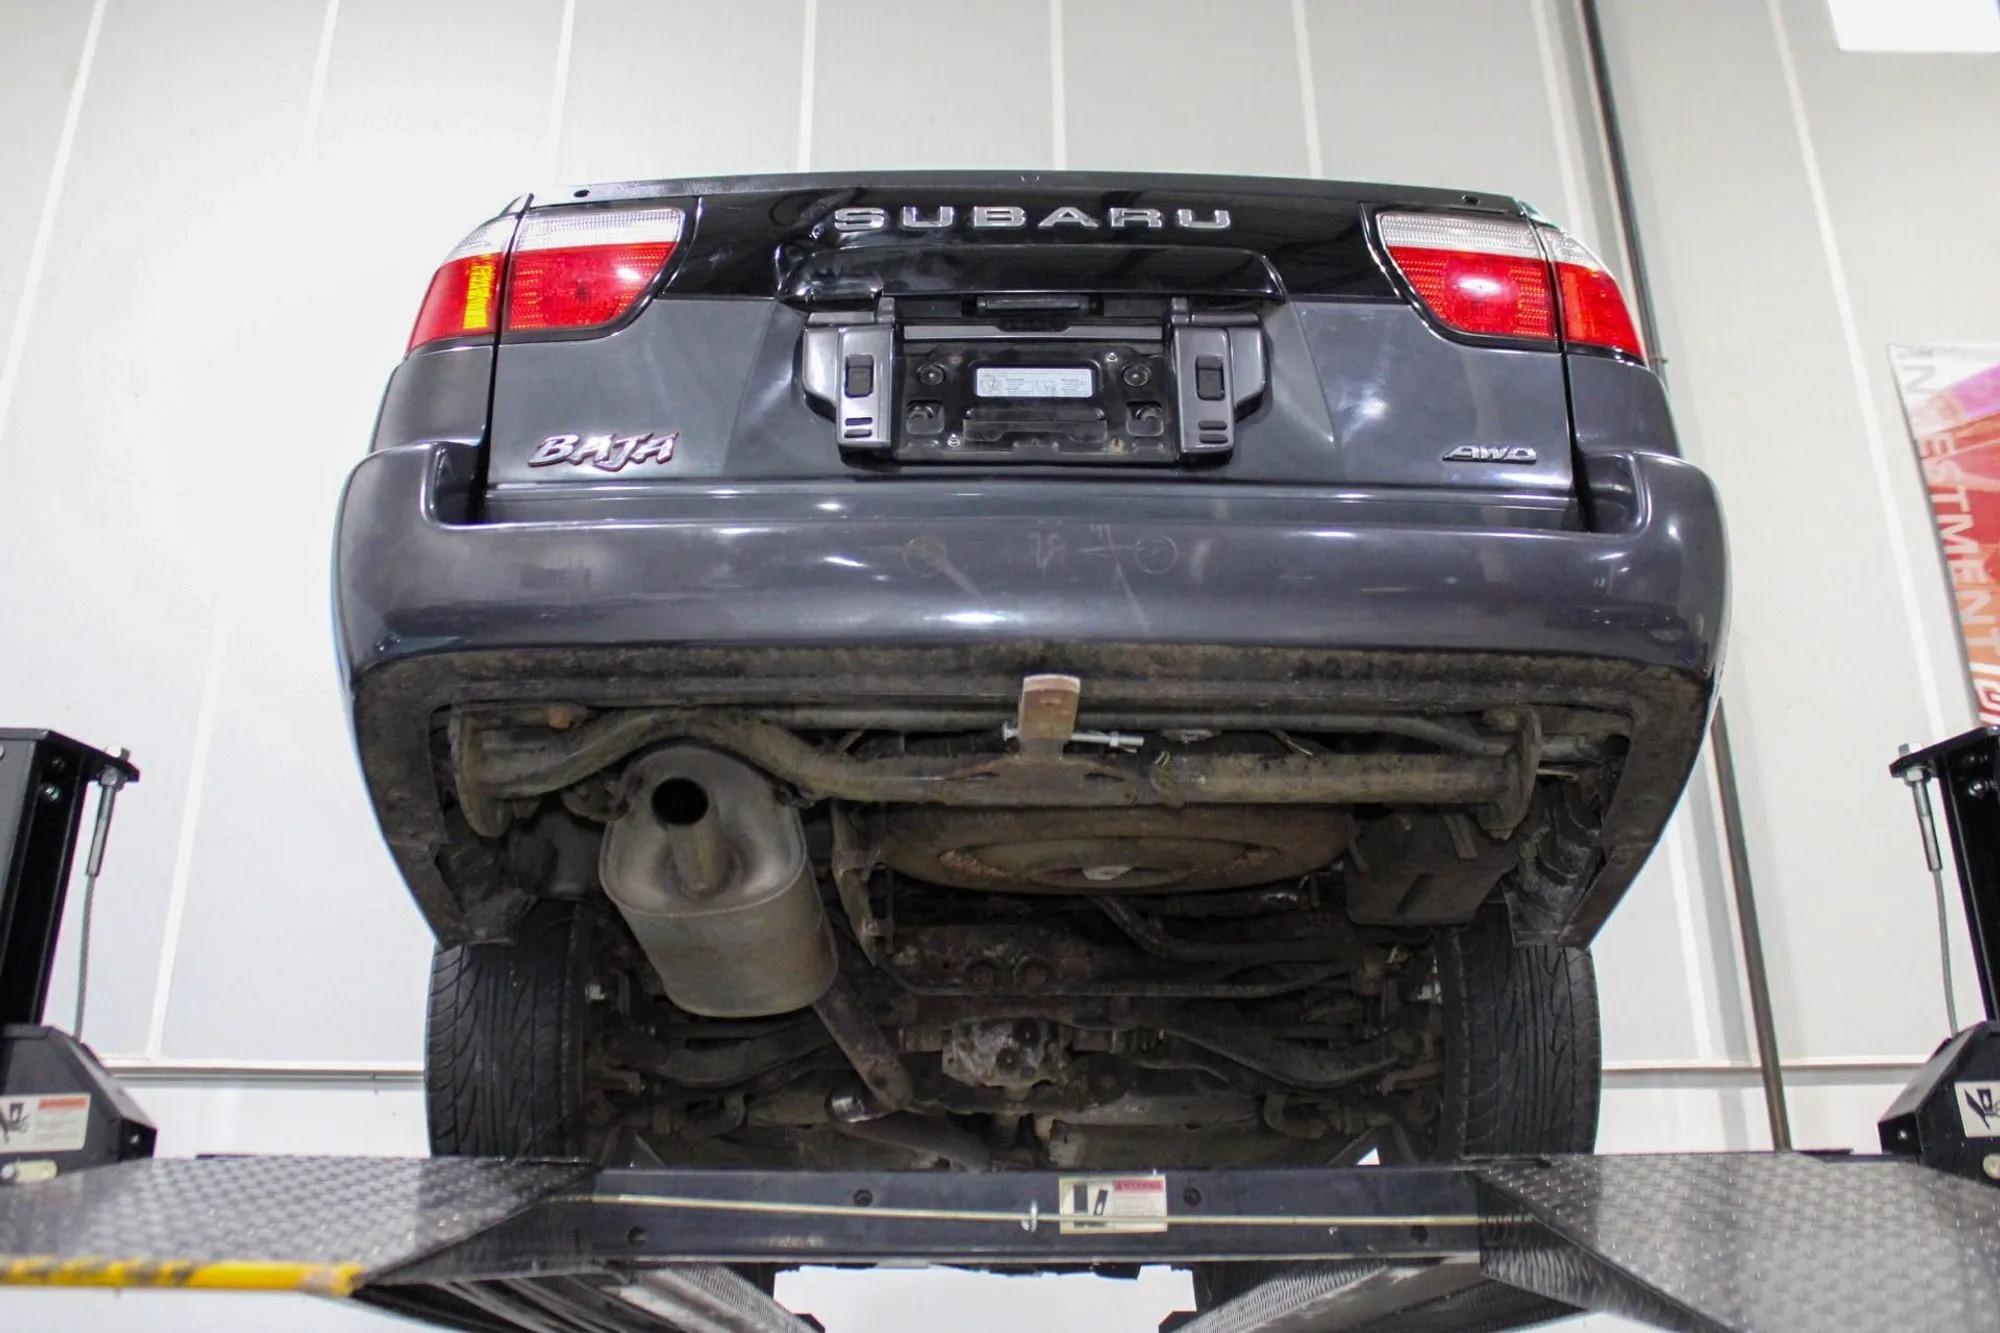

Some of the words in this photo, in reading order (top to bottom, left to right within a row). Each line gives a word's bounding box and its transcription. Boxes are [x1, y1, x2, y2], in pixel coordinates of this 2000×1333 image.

[834, 206, 1231, 231] SUBARU
[528, 432, 679, 472] BAJA
[1442, 445, 1537, 465] AWD
